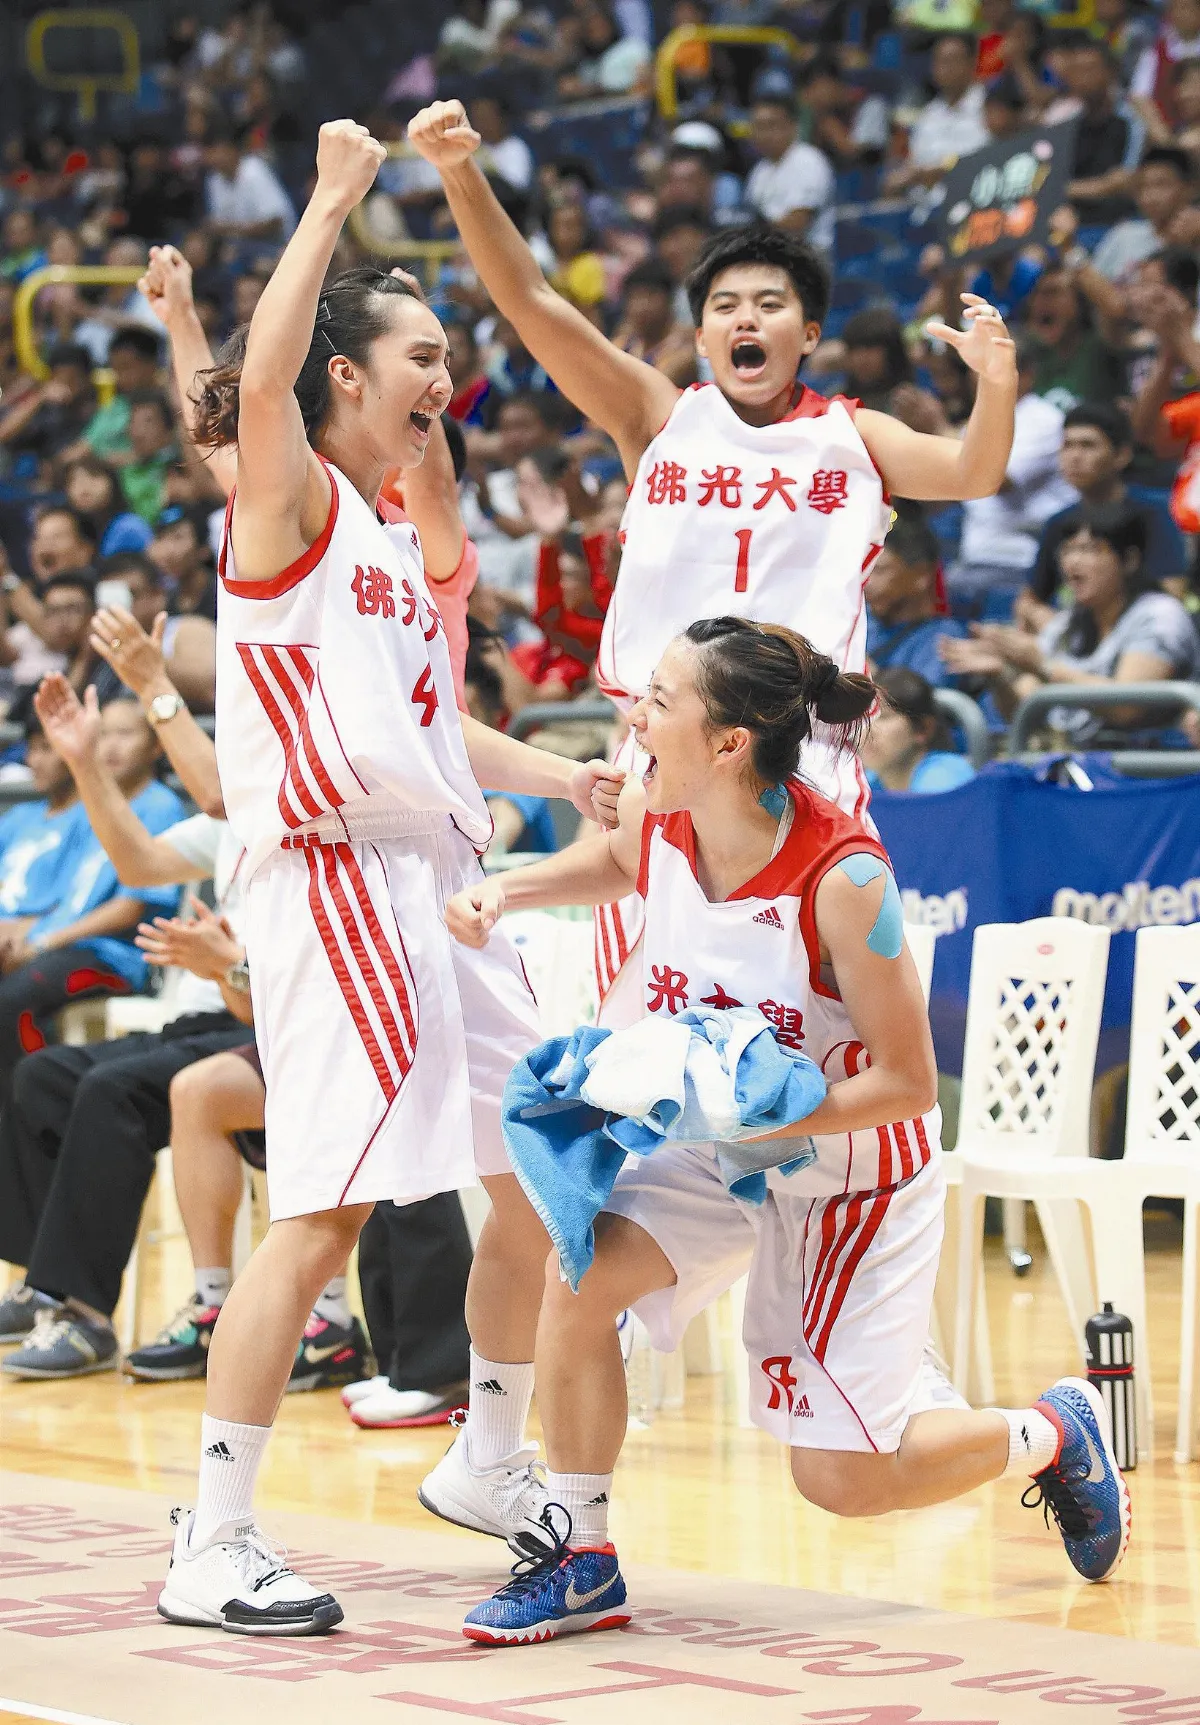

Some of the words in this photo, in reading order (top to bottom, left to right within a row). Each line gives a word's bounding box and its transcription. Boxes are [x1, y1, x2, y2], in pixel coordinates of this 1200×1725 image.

[647, 461, 848, 514] 佛光大學
[735, 529, 752, 592] 1
[411, 662, 439, 727] 4
[752, 915, 785, 931] adidas
[1051, 878, 1200, 935] molten
[205, 1449, 236, 1462] adidas
